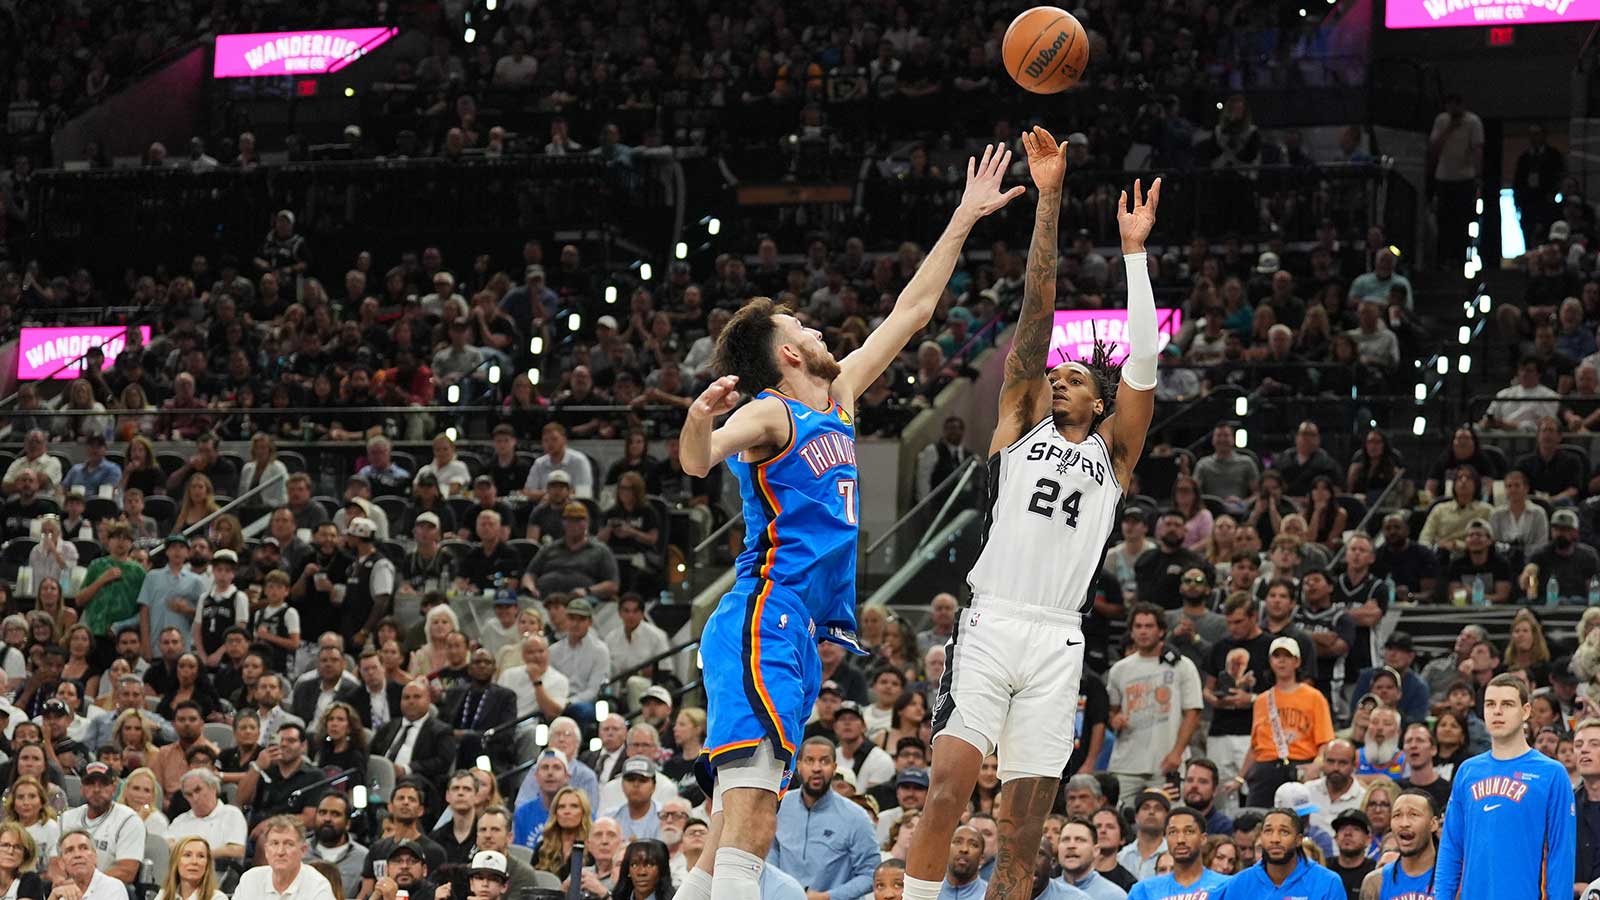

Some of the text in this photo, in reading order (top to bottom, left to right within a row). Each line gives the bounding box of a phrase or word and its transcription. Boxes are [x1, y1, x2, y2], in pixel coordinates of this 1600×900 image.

[1025, 31, 1069, 78] Wilson
[1027, 442, 1104, 487] SPURS
[837, 479, 856, 525] 7
[1028, 478, 1082, 528] 24
[1471, 776, 1528, 804] THUNDER
